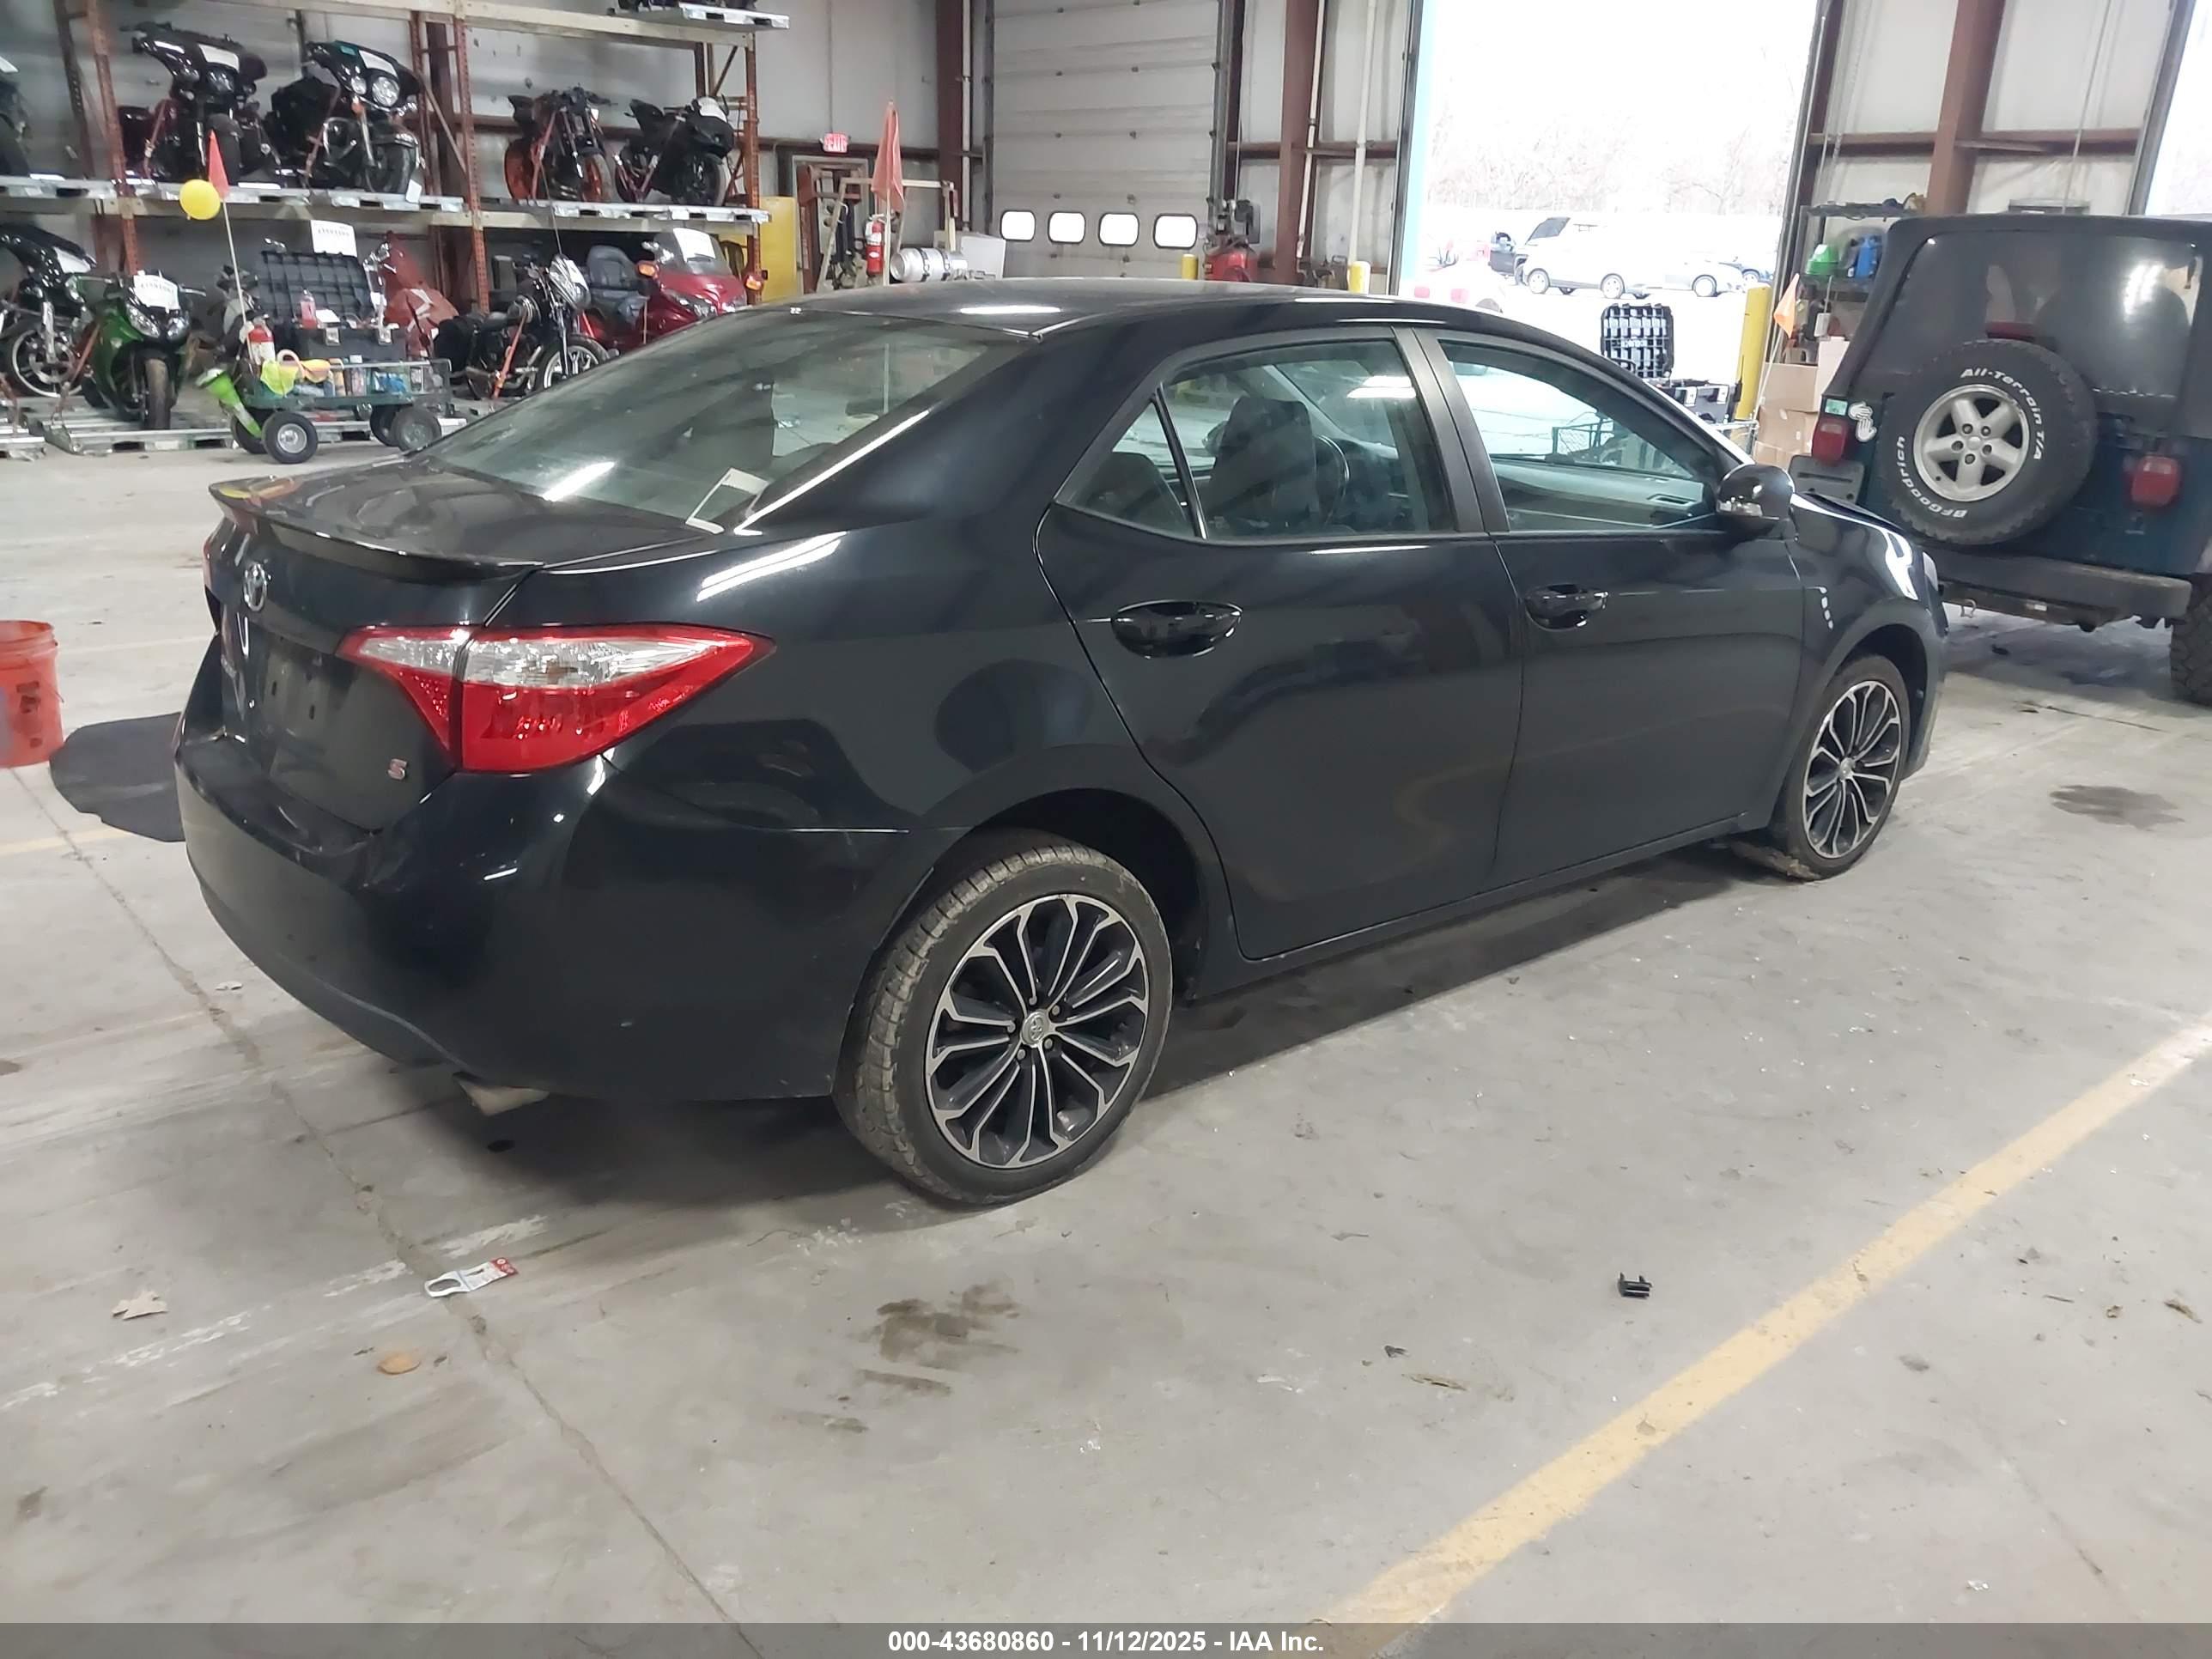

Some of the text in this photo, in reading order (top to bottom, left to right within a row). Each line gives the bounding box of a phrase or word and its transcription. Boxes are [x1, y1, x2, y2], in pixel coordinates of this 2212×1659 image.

[1960, 368, 2045, 460] All-Terrain T/A
[1897, 436, 1968, 518] BFGoodrich
[387, 758, 407, 780] S
